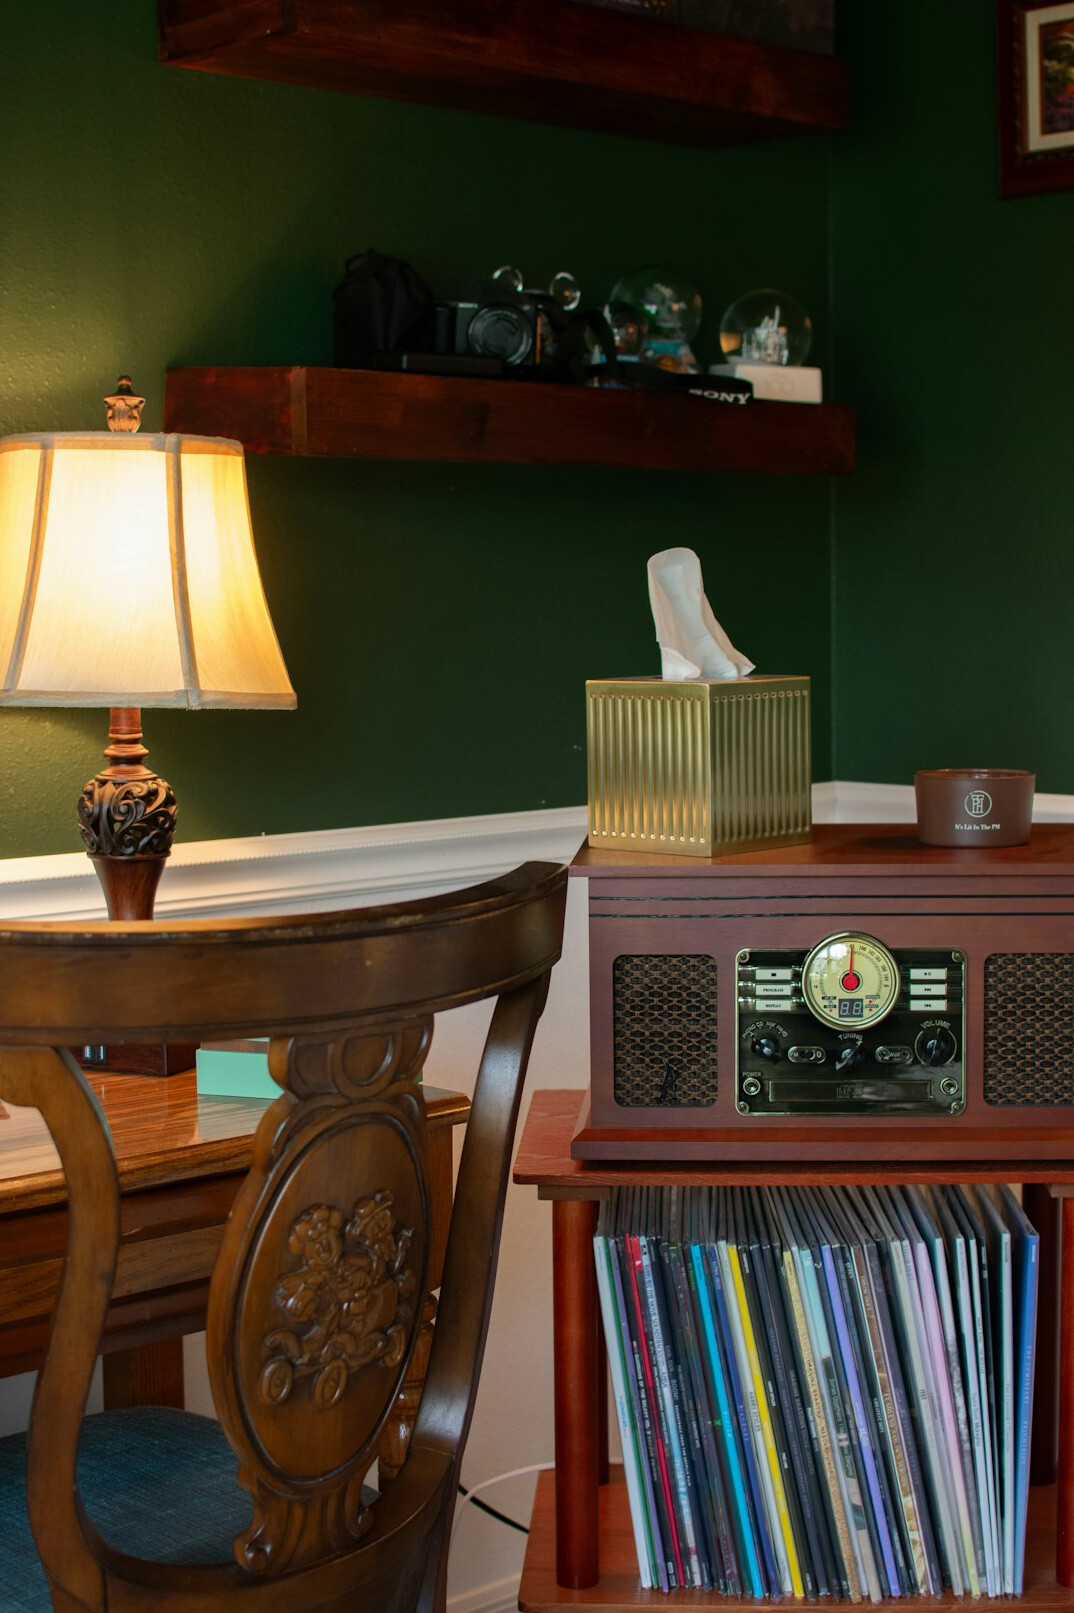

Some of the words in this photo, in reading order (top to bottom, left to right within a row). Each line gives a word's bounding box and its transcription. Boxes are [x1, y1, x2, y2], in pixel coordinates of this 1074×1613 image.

[920, 1020, 951, 1029] VOLUME
[788, 1369, 798, 1397] IMAGINE
[794, 1397, 805, 1429] DRAGONS
